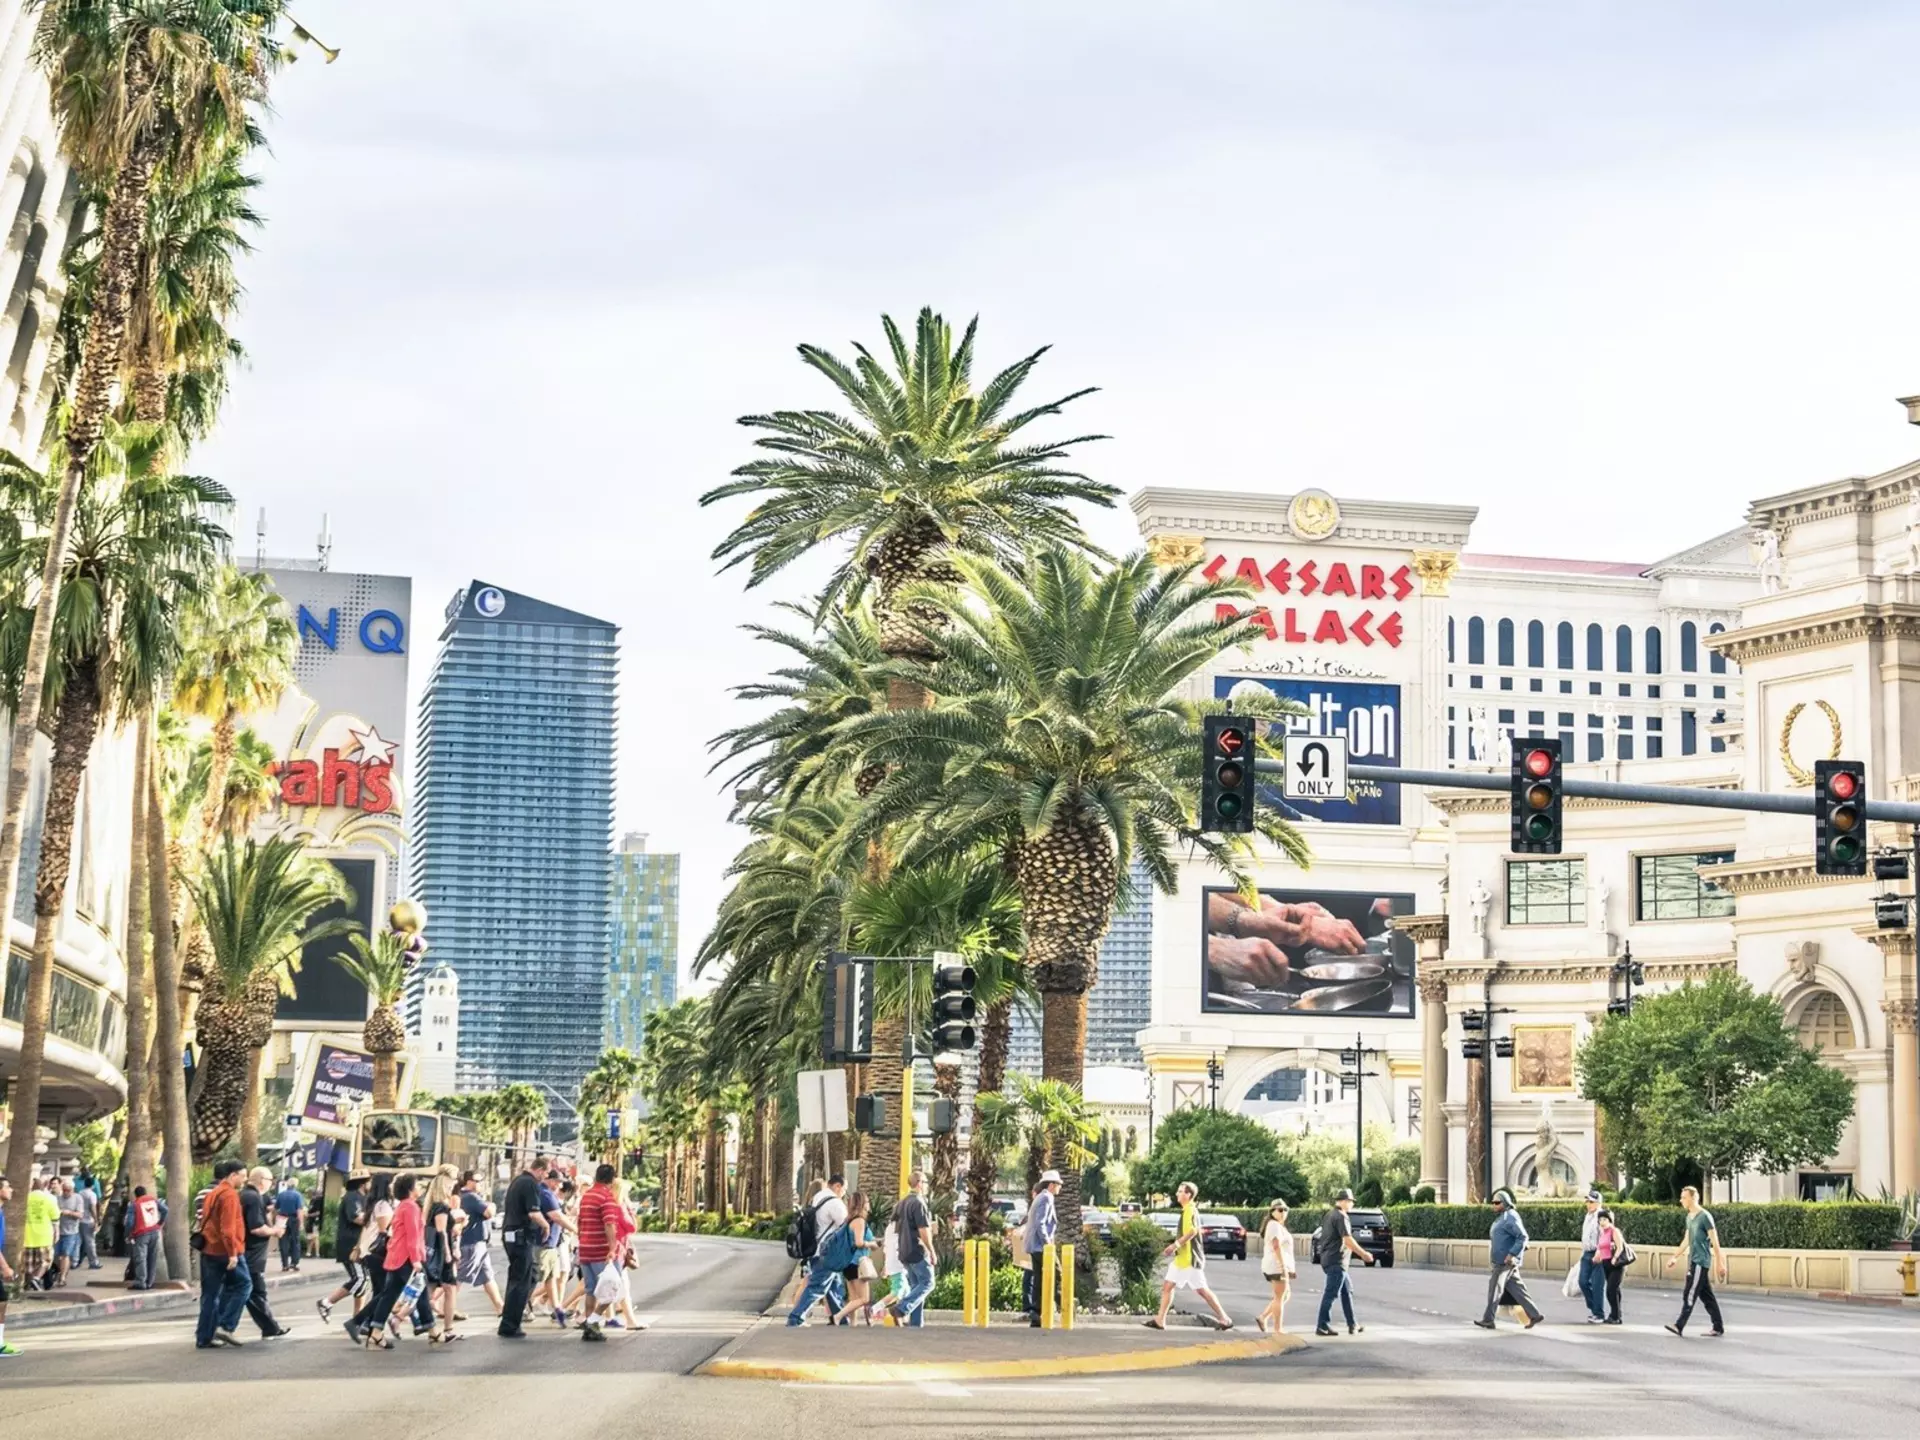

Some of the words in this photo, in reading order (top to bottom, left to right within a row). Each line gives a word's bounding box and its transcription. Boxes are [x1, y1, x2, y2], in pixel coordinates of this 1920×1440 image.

[1201, 554, 1414, 601] CAESARS
[1297, 780, 1334, 795] ONLY
[315, 1080, 333, 1092] REAL
